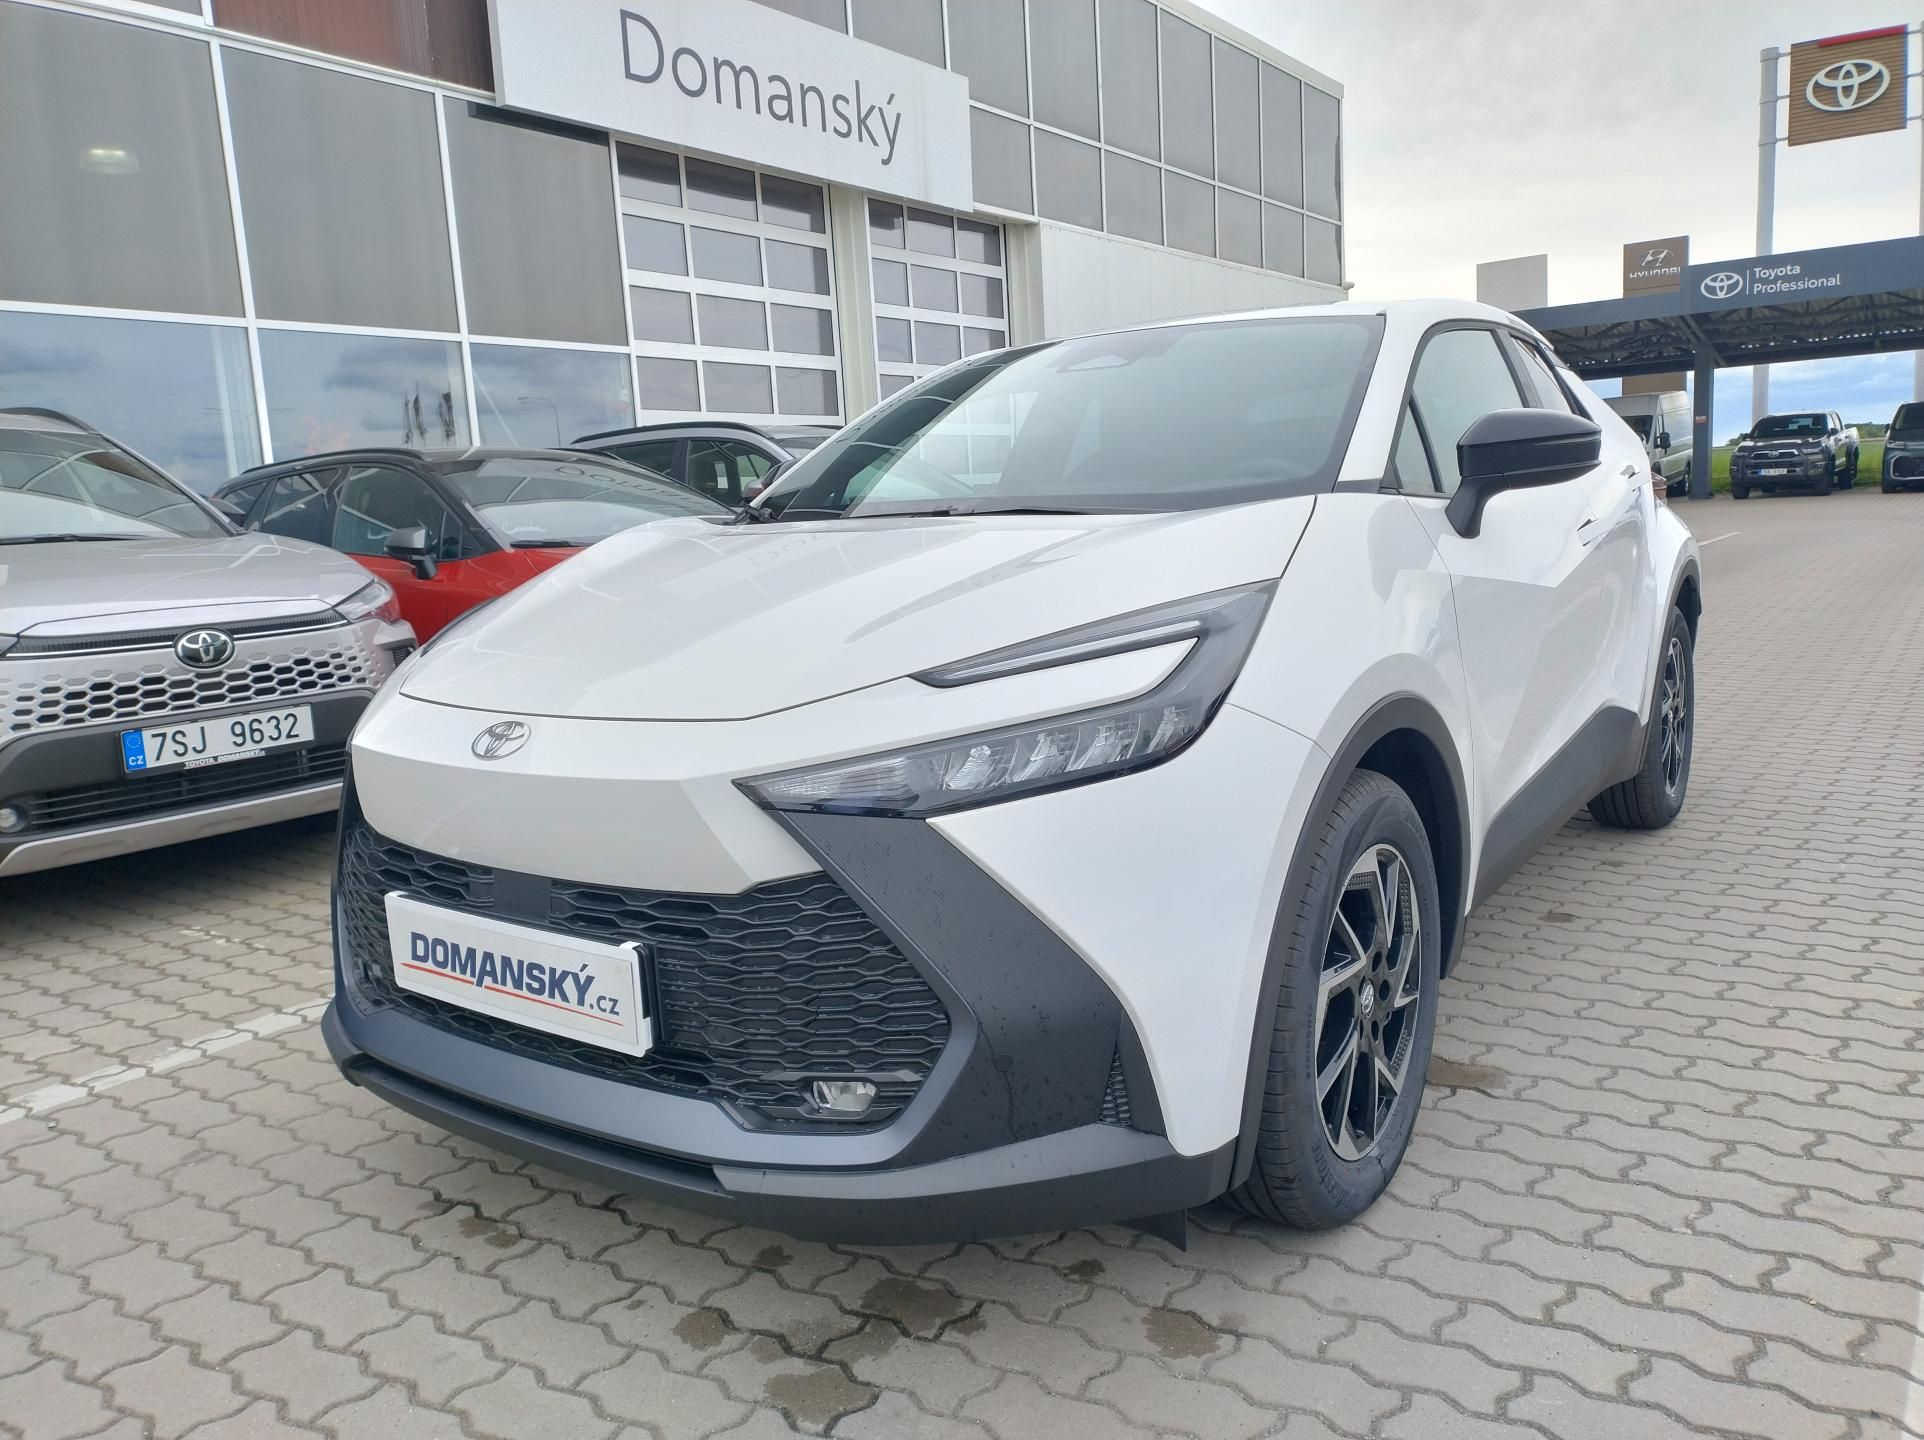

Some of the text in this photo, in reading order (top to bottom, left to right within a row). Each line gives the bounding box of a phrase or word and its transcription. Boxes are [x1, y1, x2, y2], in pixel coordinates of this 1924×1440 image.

[619, 8, 901, 166] Domanský
[1753, 264, 1801, 279] Toyota
[1753, 274, 1841, 294] Professional
[128, 712, 300, 766] CZ 7SJ 9632
[184, 757, 215, 769] TOYOTA
